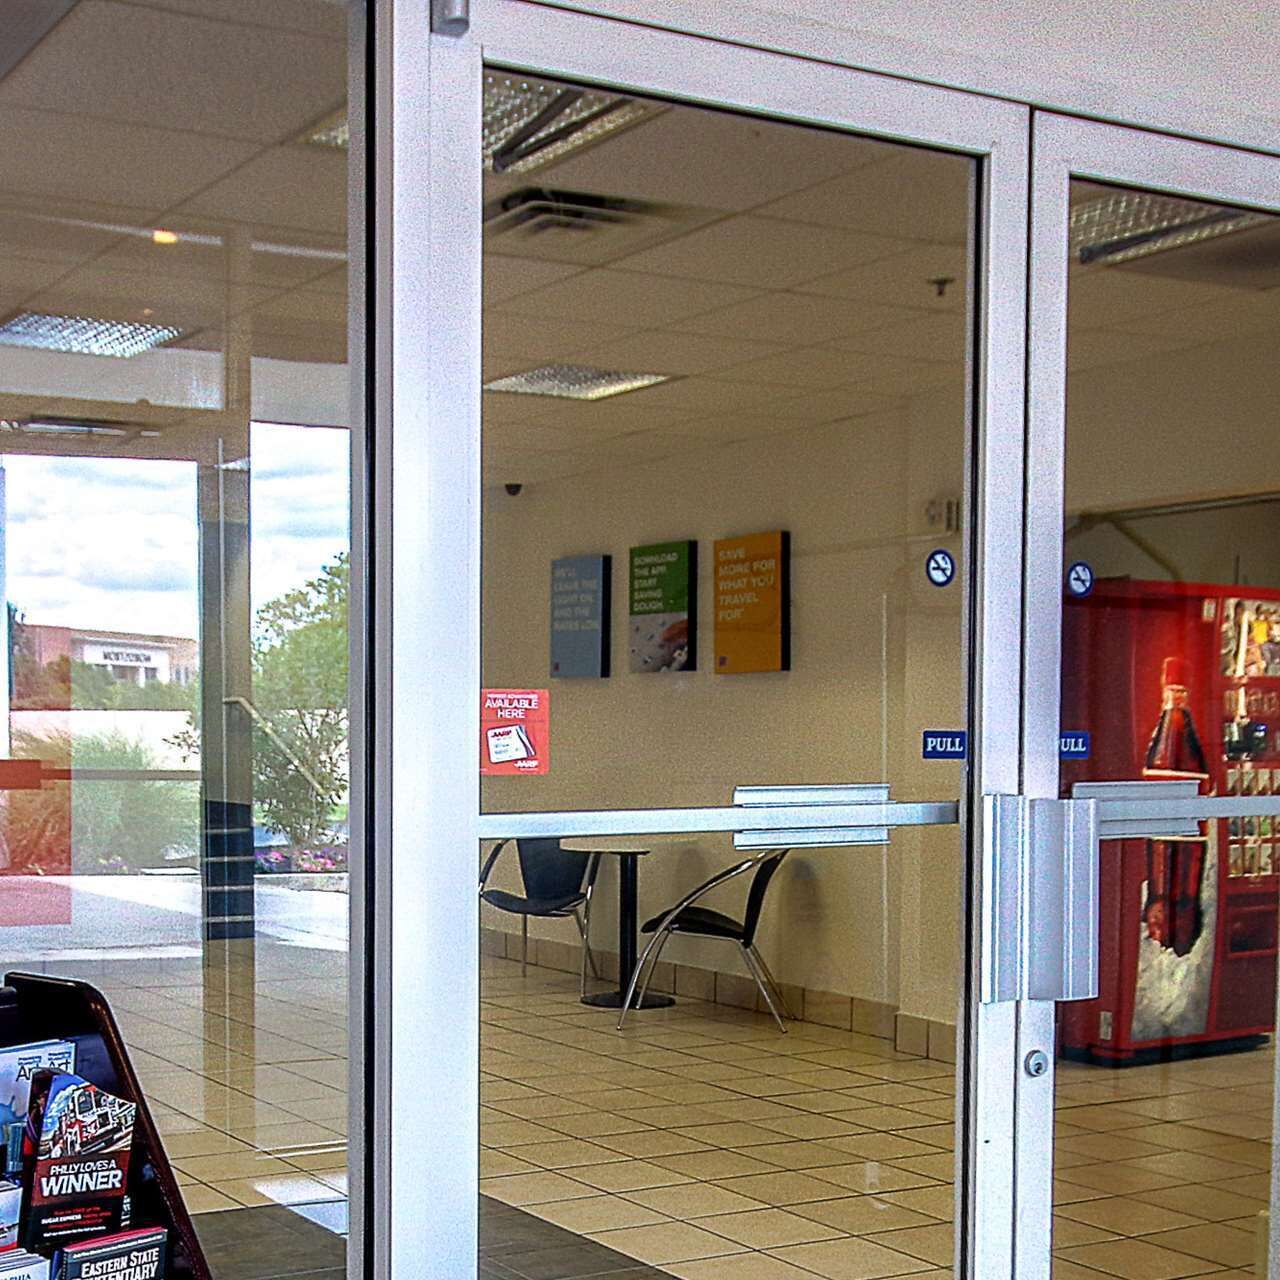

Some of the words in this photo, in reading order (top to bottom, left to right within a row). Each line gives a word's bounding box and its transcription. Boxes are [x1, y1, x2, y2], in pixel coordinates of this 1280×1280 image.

[485, 699, 538, 709] AVAILABLE
[498, 709, 525, 718] HERE
[926, 738, 963, 752] PULL
[40, 1168, 122, 1197] WINNER
[81, 1255, 129, 1278] EASTERN
[130, 1248, 159, 1268] STATE
